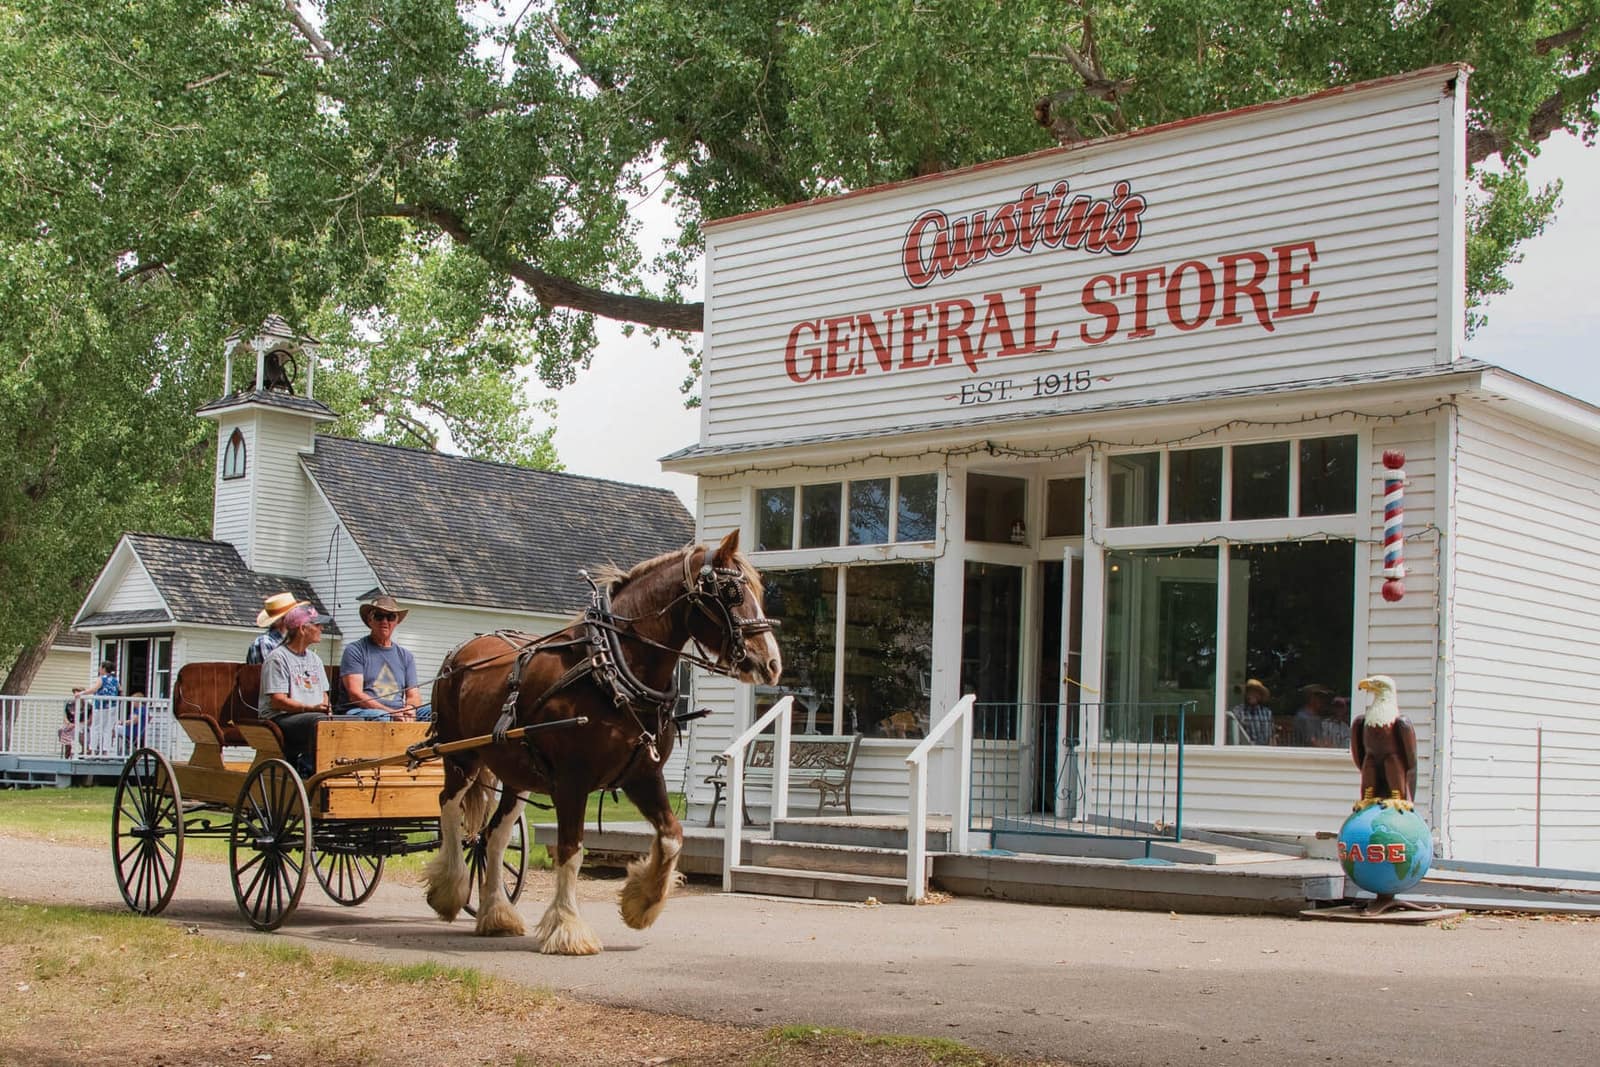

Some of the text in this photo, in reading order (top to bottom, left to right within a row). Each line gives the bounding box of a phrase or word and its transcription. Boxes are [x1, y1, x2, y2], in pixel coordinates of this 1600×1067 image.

[902, 180, 1147, 288] Austin's
[783, 240, 1321, 383] GENERAL STORE
[1033, 370, 1092, 397] 1915
